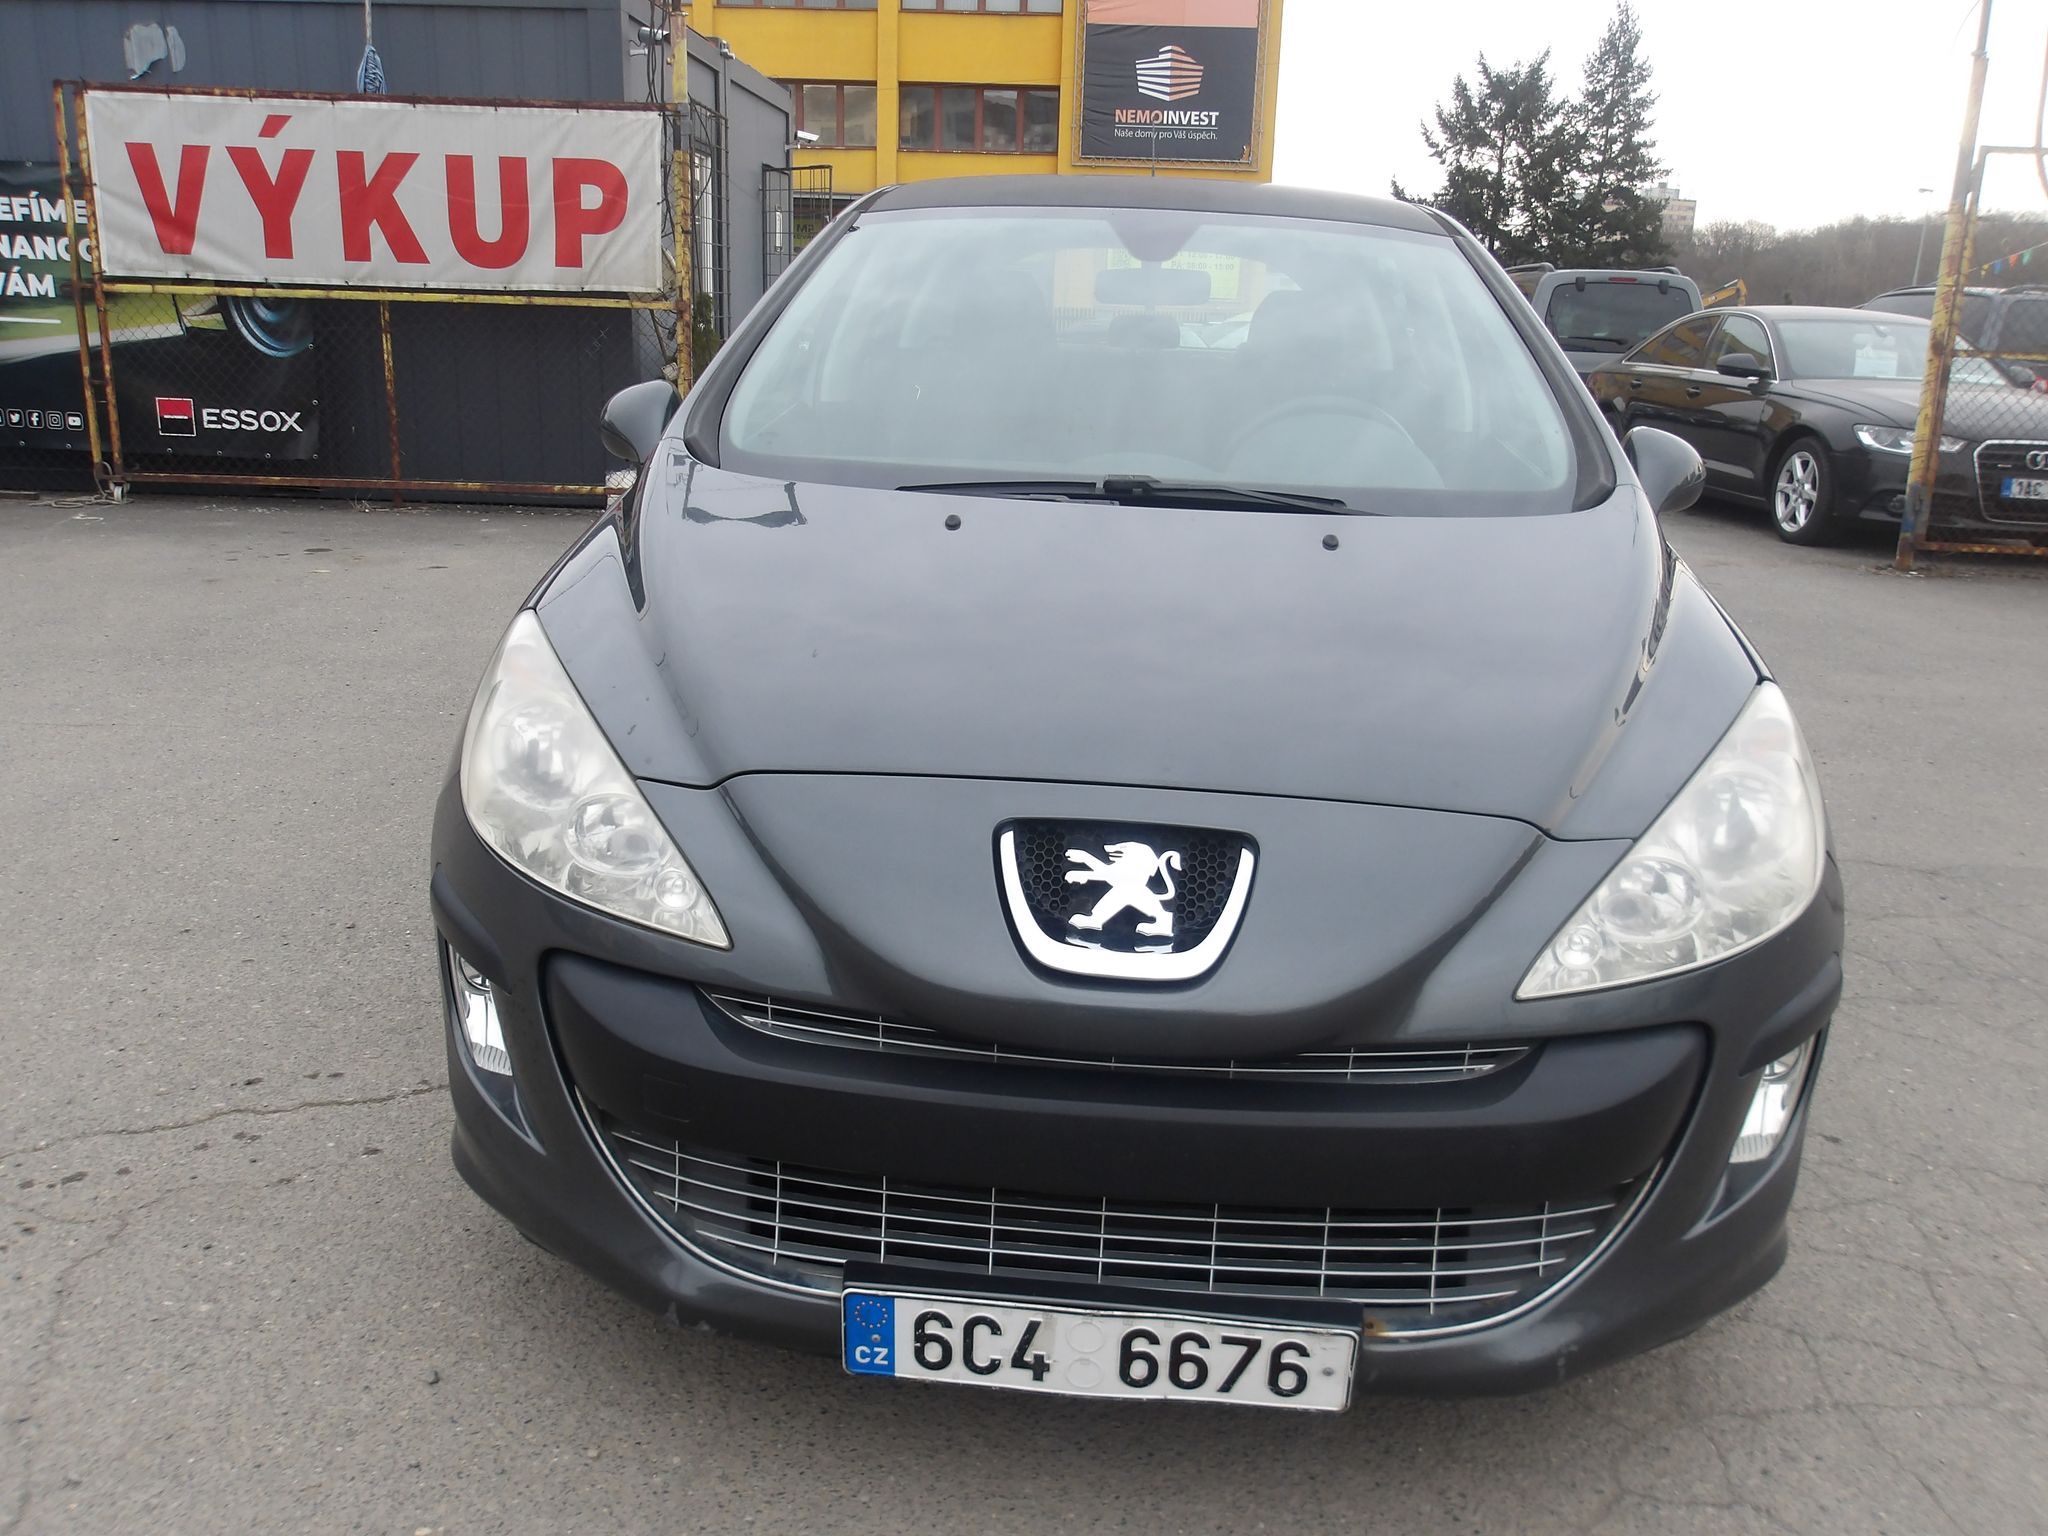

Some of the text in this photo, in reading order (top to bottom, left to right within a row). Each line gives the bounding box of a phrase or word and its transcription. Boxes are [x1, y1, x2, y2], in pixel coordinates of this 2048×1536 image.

[1115, 109, 1219, 126] NEMOINVEST
[1114, 128, 1218, 140] Naše domy pro Váš úspěch.
[125, 114, 630, 270] VÝKUP
[202, 408, 304, 432] ESSOX
[854, 1310, 1312, 1398] CZ 6C4 6676
